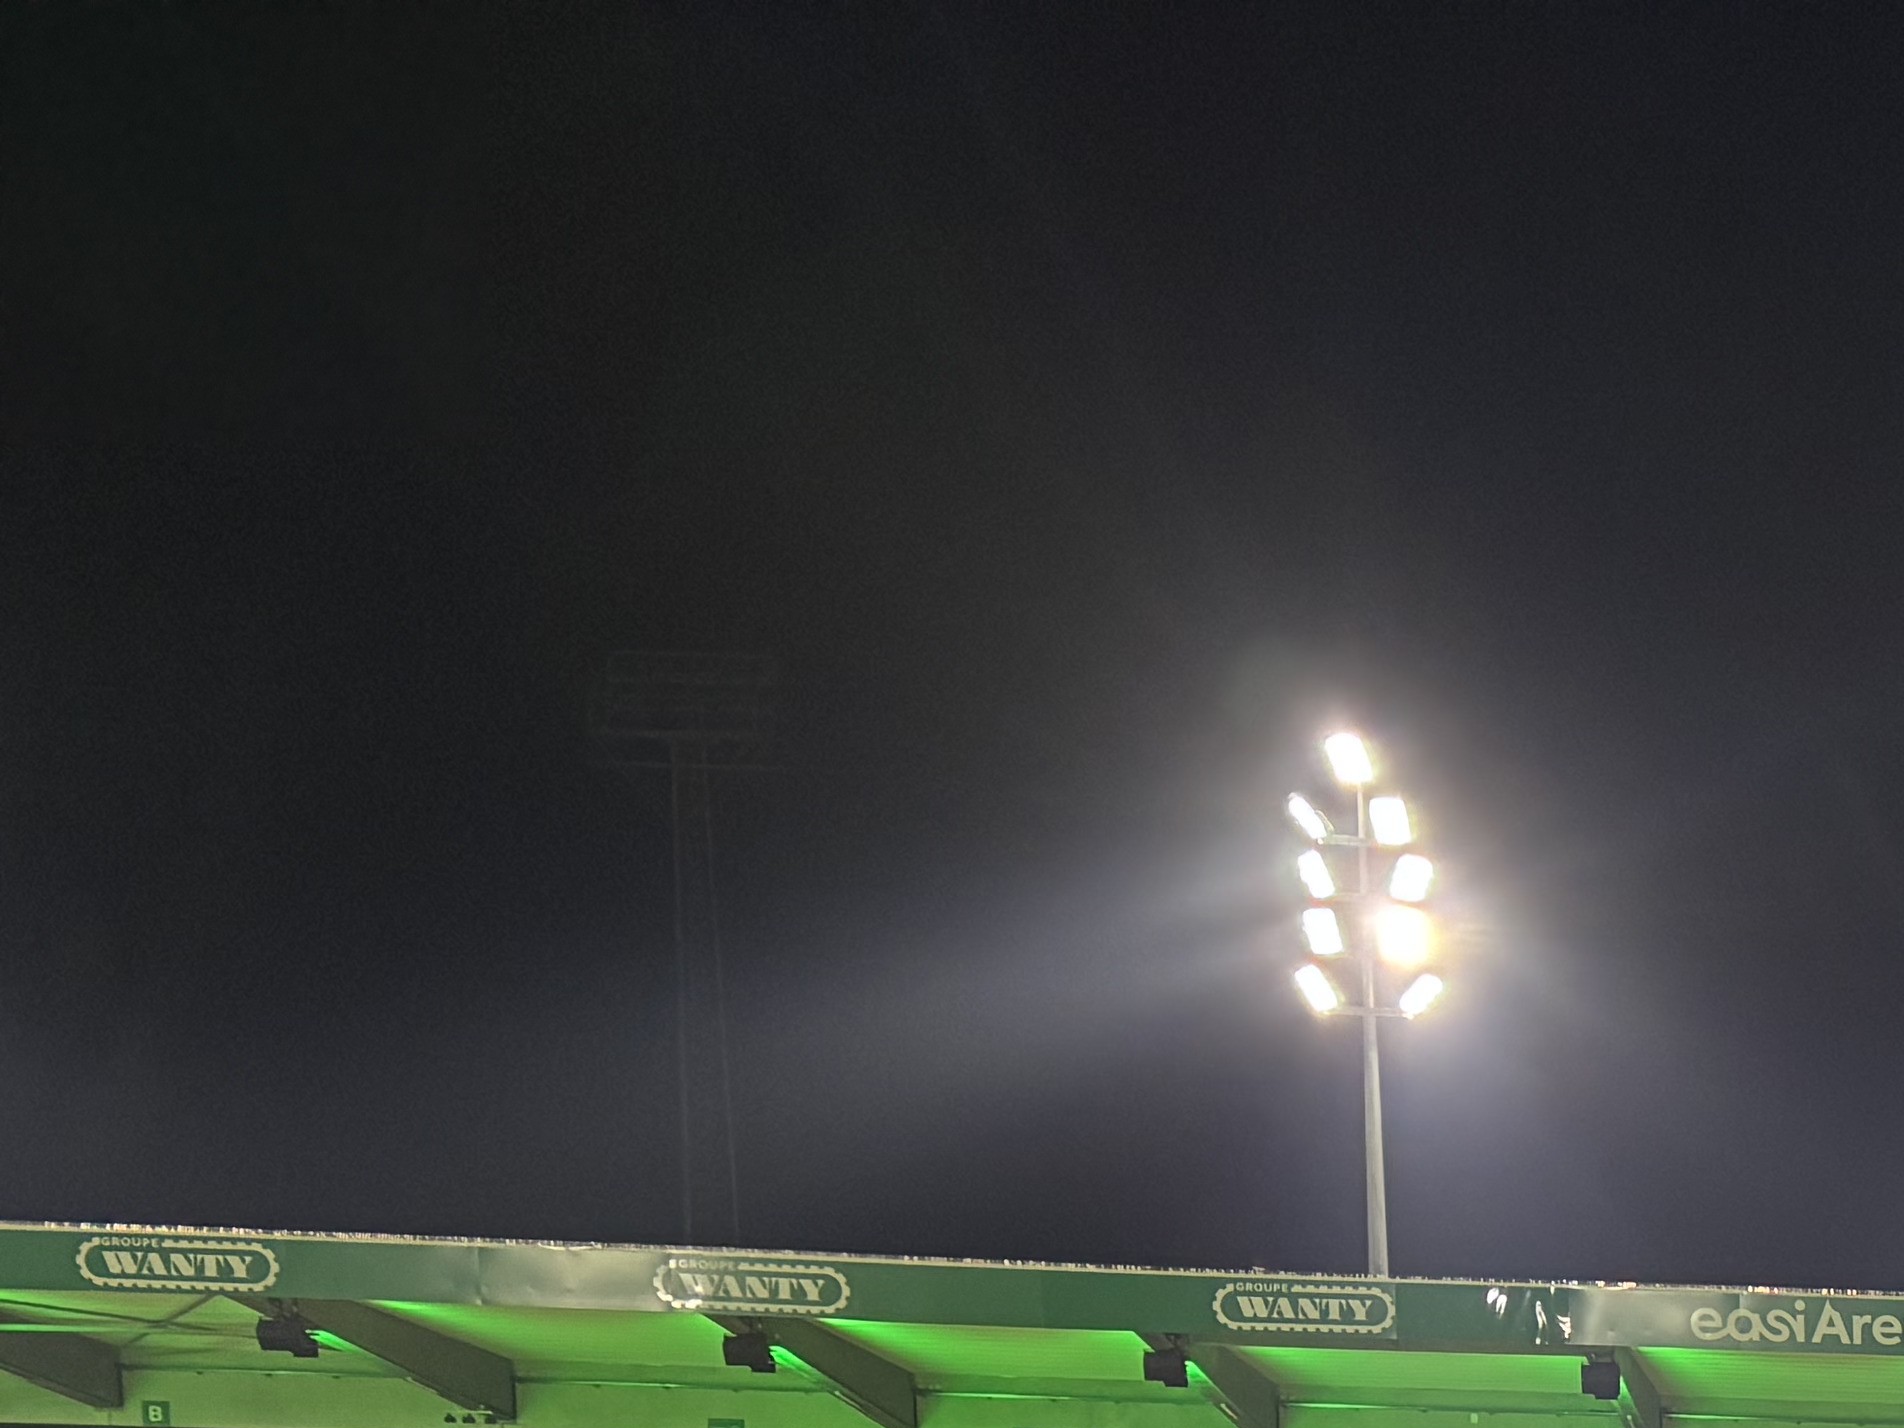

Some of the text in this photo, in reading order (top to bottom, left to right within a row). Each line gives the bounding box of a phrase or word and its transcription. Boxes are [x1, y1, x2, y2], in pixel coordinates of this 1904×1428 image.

[101, 1250, 253, 1278] WANTY
[678, 1273, 825, 1301] WANTY
[1236, 1296, 1373, 1320] WANTY
[148, 1405, 163, 1422] B
